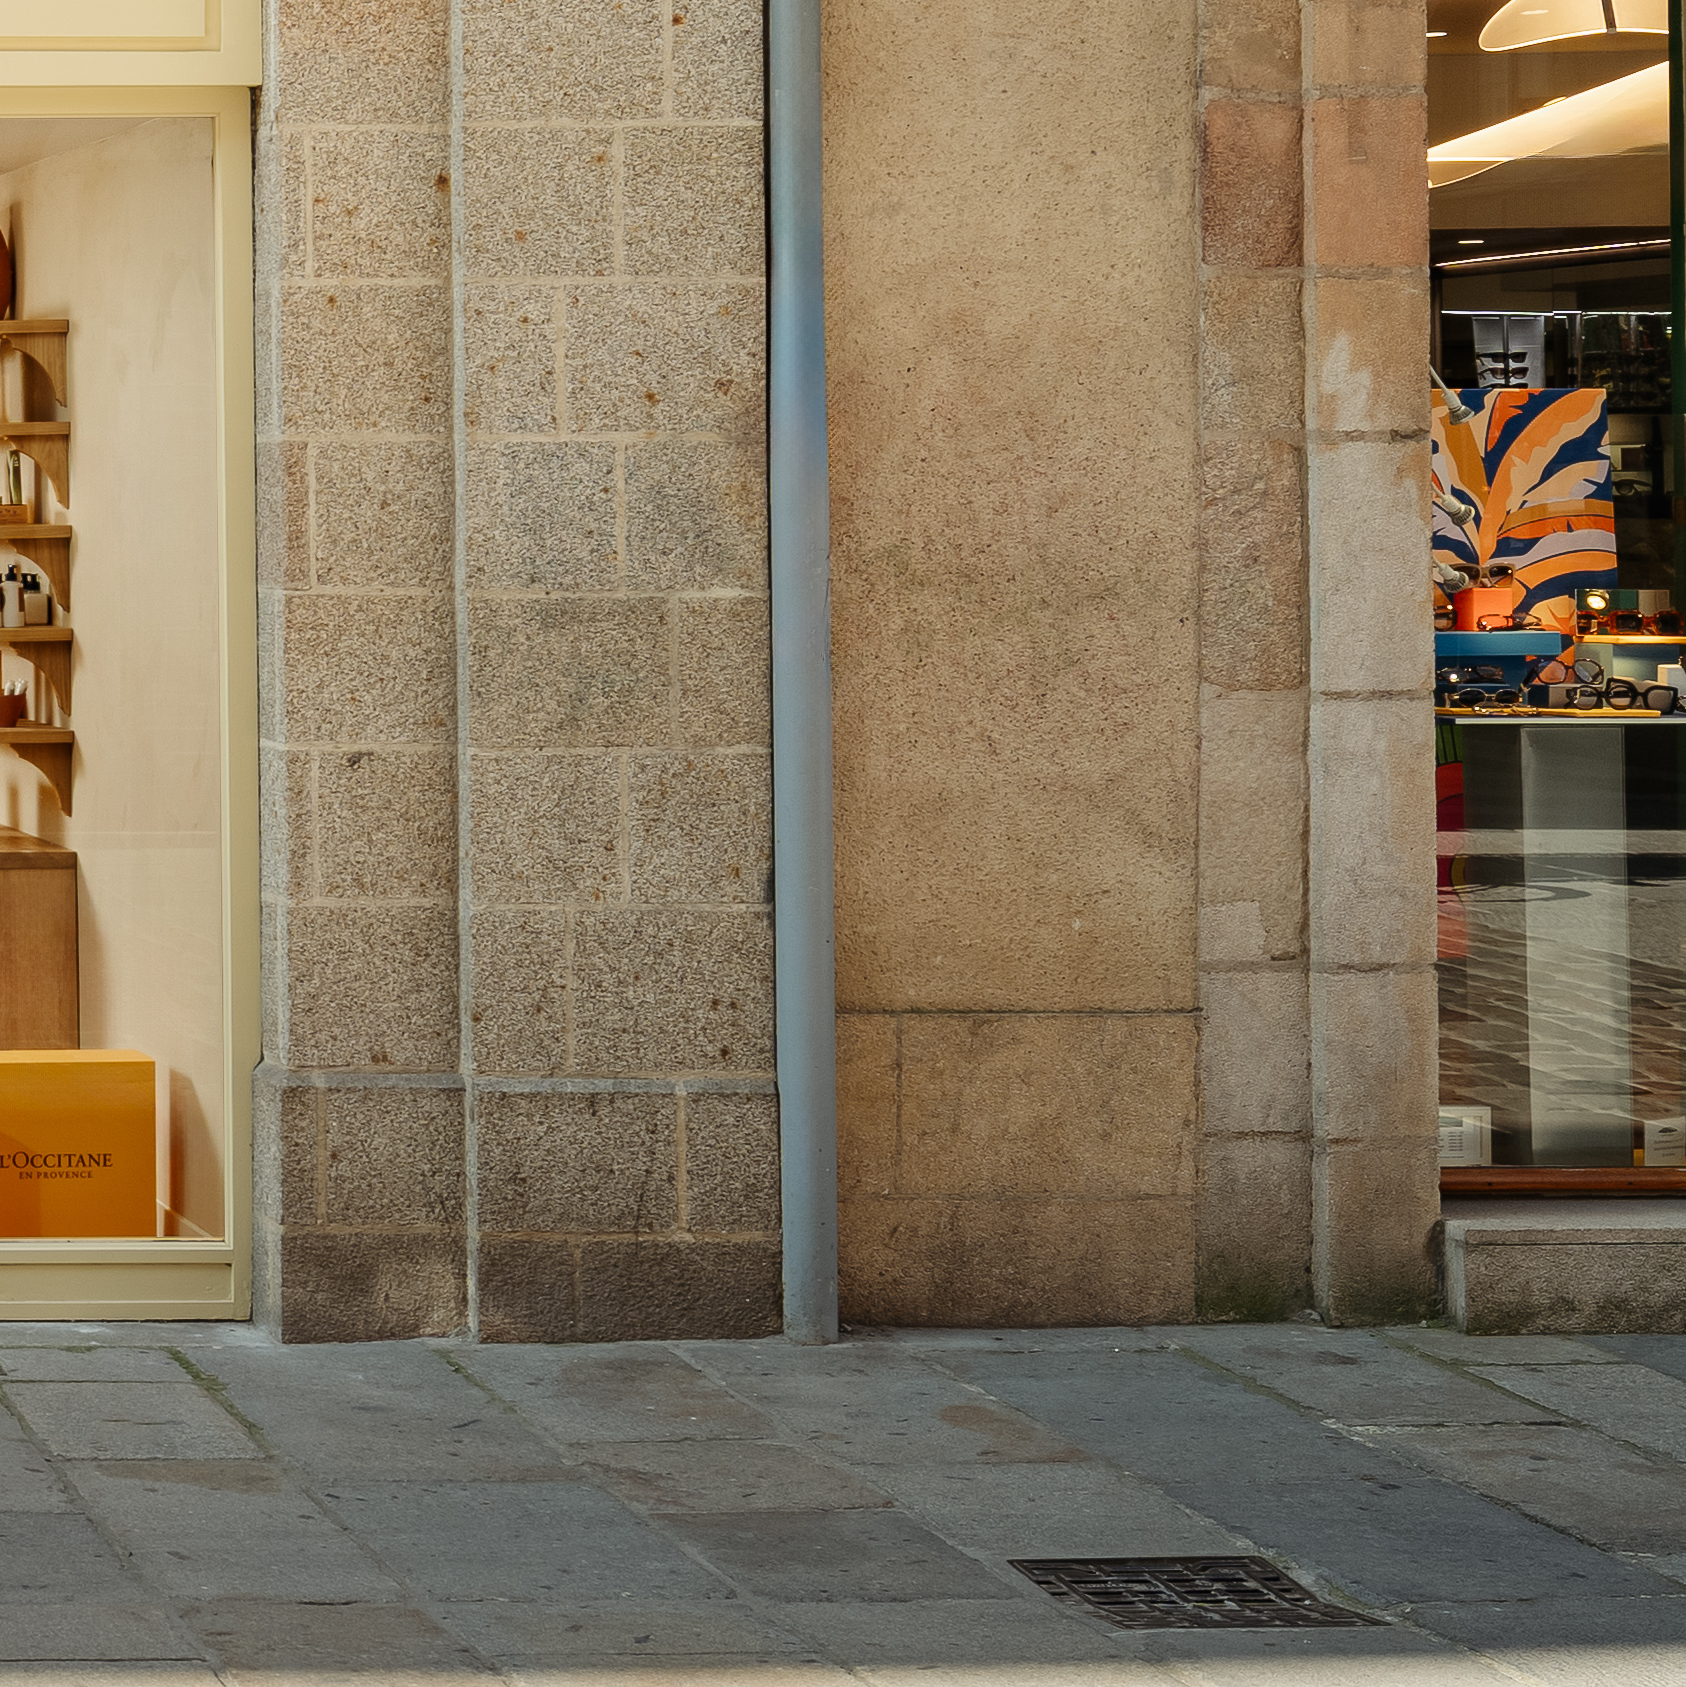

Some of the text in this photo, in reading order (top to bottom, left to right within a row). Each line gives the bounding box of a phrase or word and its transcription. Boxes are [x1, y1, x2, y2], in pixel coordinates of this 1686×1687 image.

[0, 1151, 113, 1169] L'OCCITANE
[18, 1171, 93, 1180] EN PROVENCE
